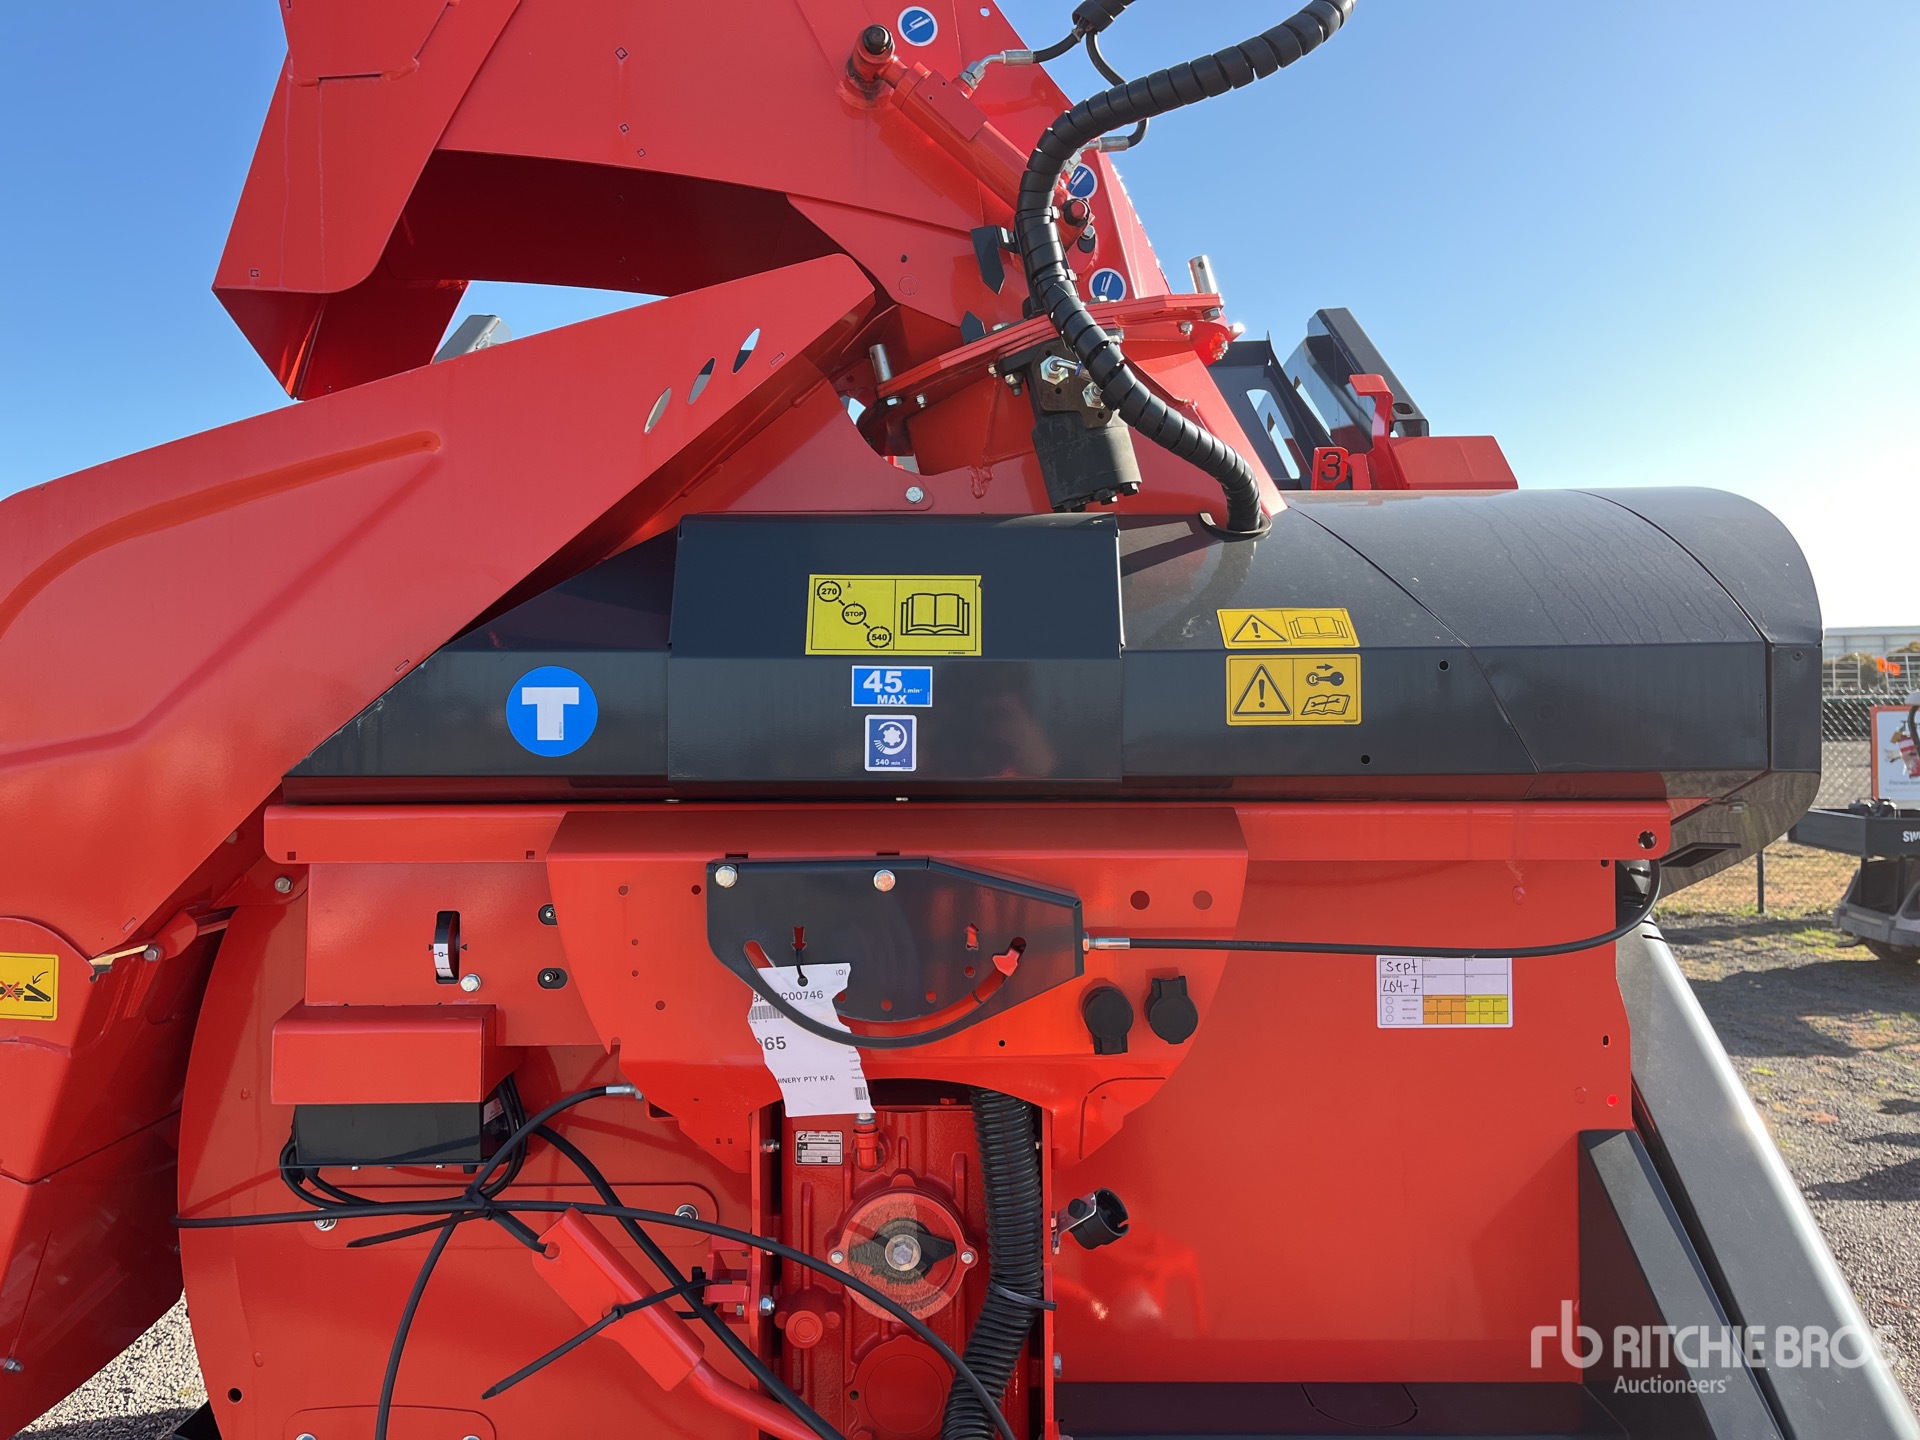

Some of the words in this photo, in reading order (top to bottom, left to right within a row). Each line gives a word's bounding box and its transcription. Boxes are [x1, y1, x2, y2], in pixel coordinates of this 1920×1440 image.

[1321, 452, 1341, 481] 3
[821, 587, 837, 595] 270
[871, 633, 887, 641] 540
[863, 670, 903, 693] 45
[876, 694, 908, 705] MAX
[521, 686, 580, 741] T
[875, 758, 890, 766] 540
